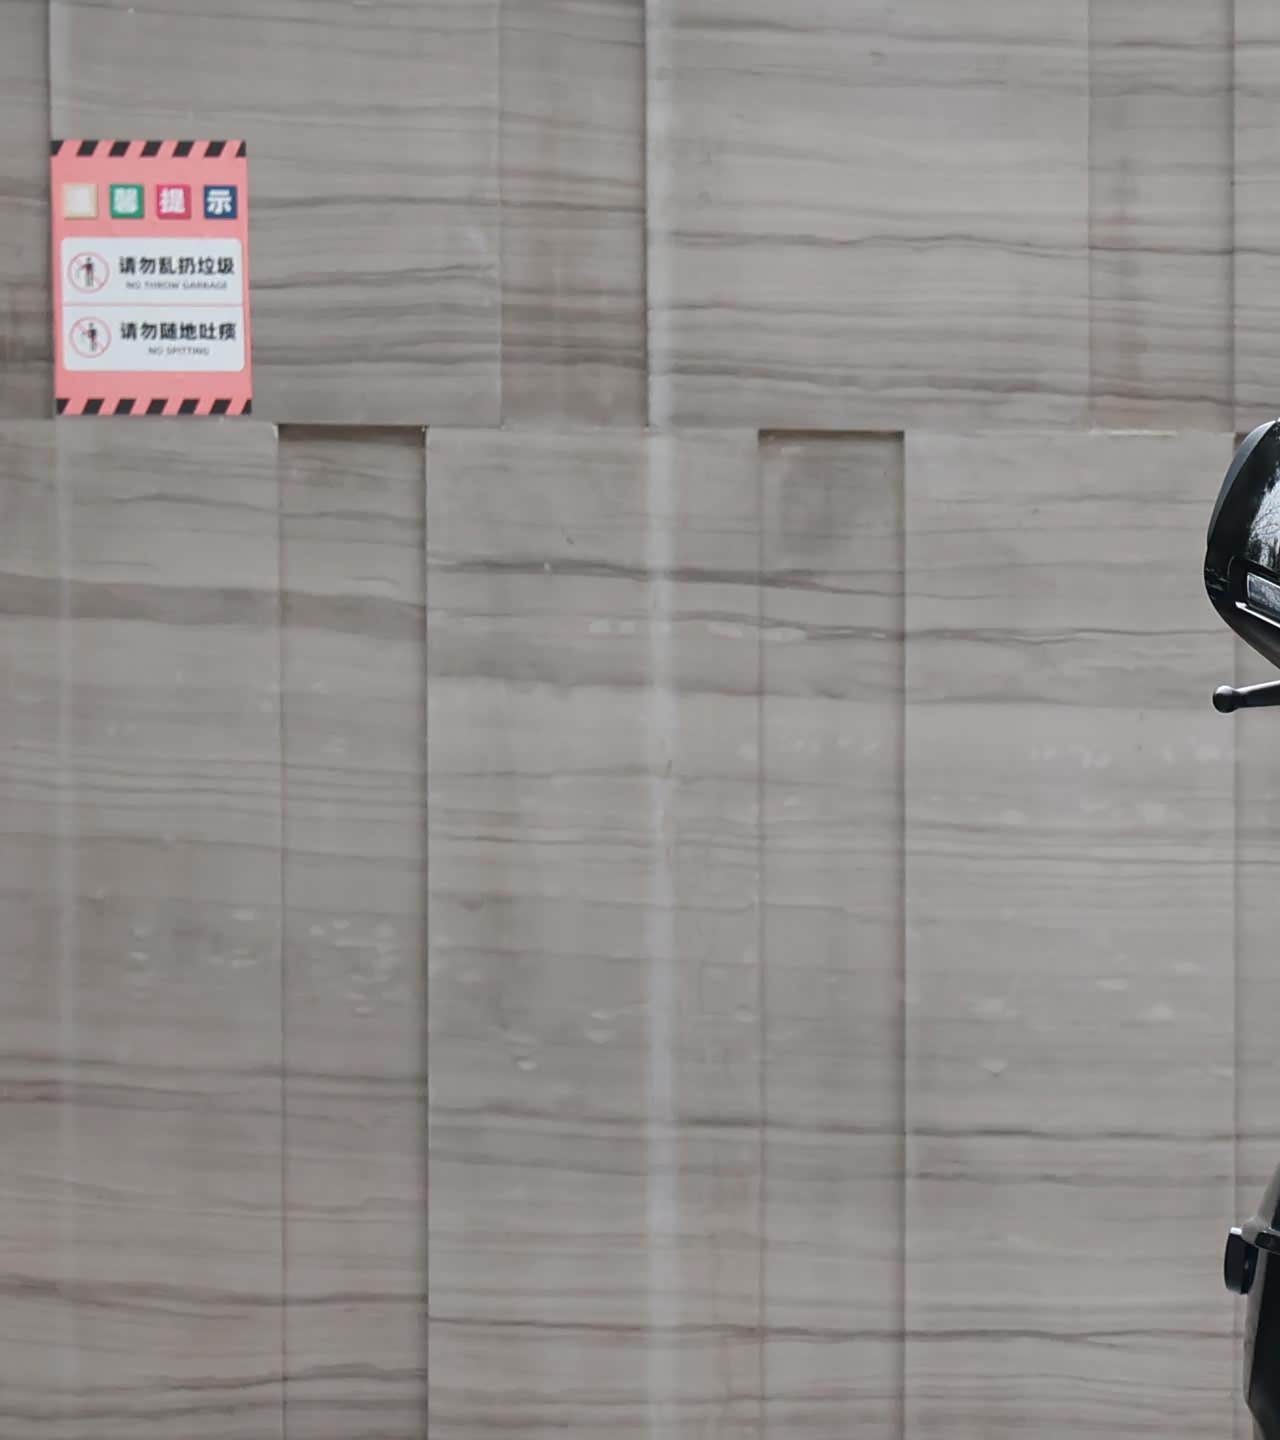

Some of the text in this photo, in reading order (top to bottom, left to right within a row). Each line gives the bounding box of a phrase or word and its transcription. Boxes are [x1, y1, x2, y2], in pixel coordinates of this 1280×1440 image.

[119, 256, 235, 275] 请勿乱扔垃圾
[126, 281, 140, 289] NO
[120, 322, 237, 341] 请勿随地吐痰
[148, 347, 162, 355] NO
